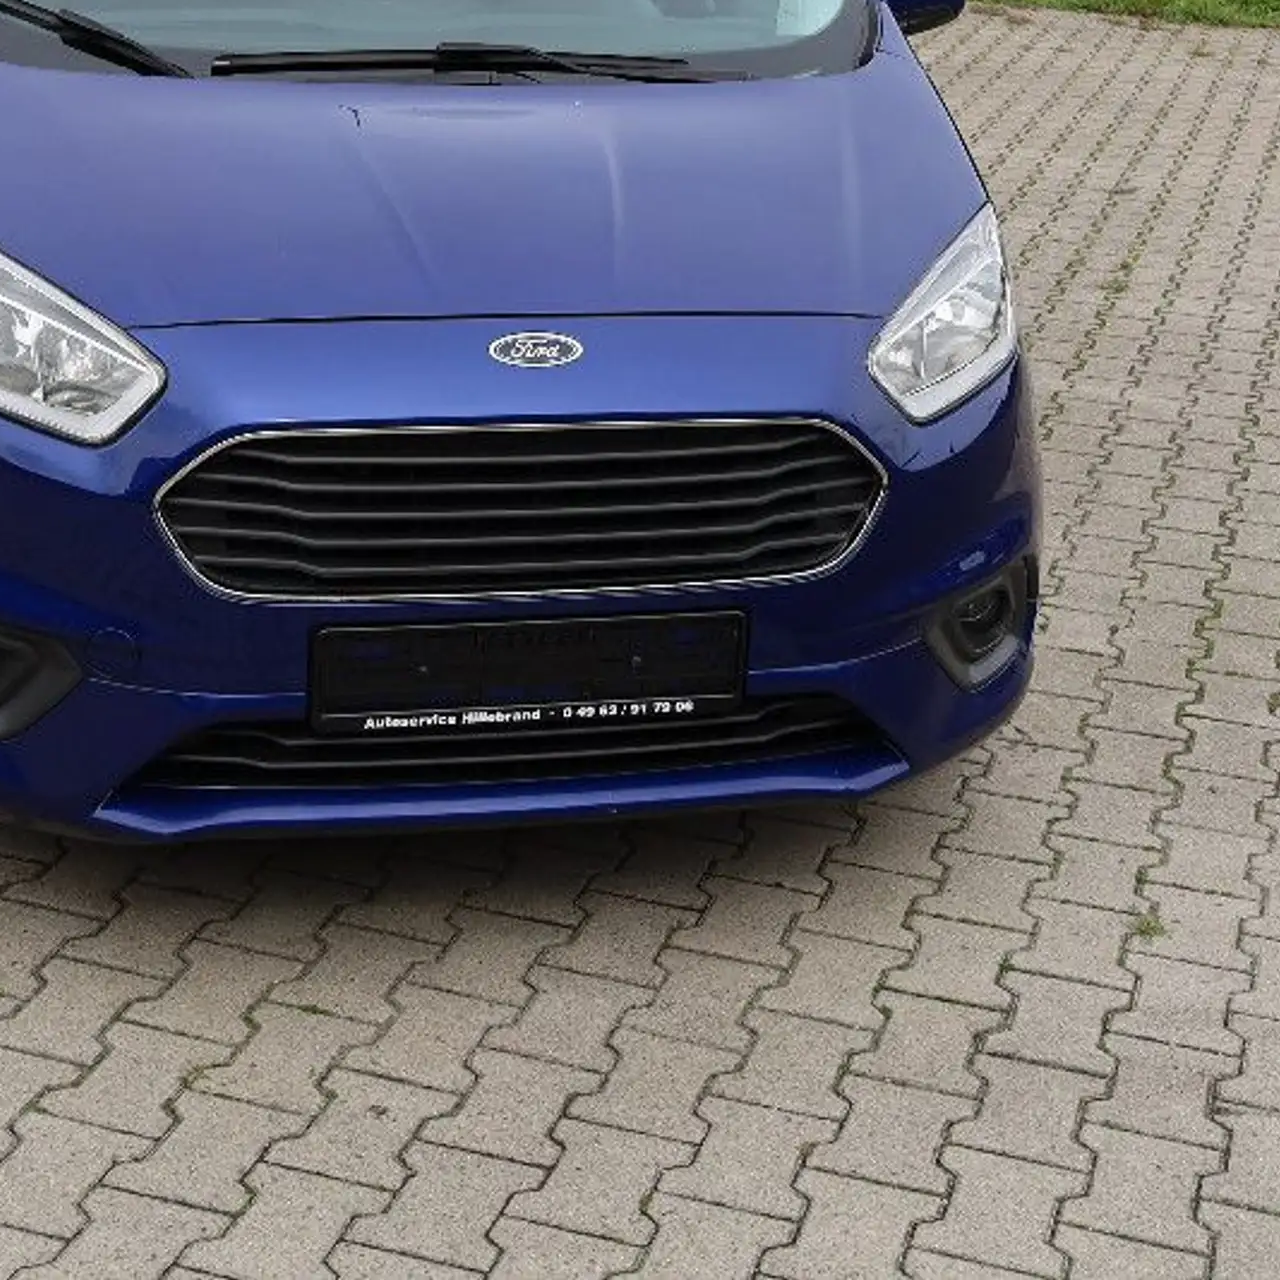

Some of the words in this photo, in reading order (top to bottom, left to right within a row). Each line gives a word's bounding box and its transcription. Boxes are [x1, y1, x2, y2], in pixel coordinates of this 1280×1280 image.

[510, 339, 560, 358] Ford
[364, 714, 456, 729] Autoservice
[461, 709, 541, 724] Hillebrand
